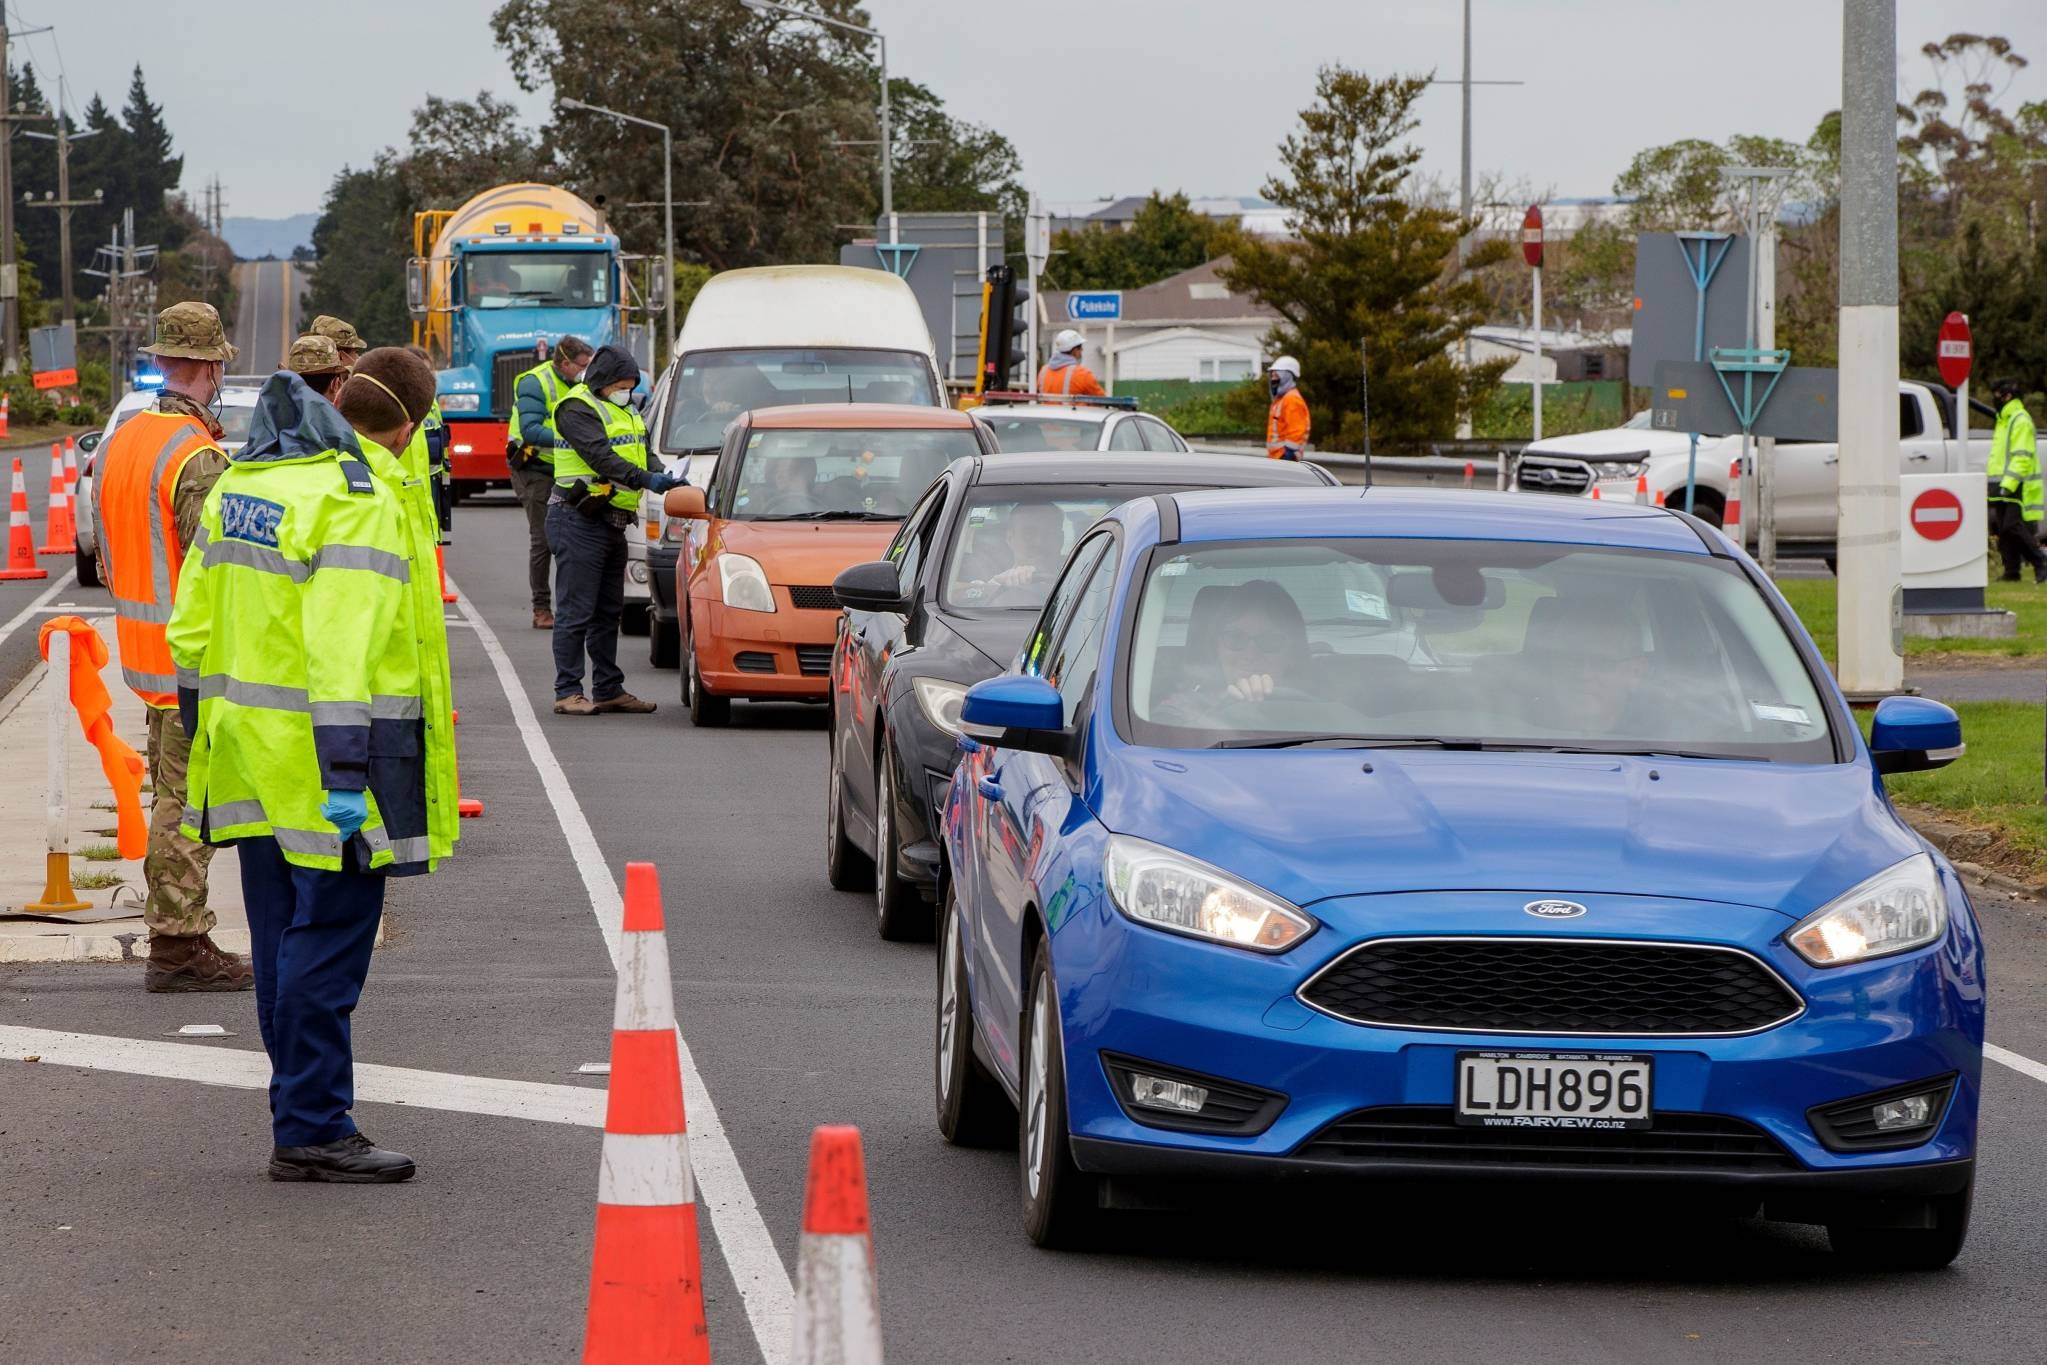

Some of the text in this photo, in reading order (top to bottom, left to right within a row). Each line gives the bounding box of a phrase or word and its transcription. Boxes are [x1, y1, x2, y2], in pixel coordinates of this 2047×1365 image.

[453, 382, 476, 390] 334
[1538, 903, 1573, 914] Ford
[1466, 1066, 1642, 1113] LDH896
[1484, 1116, 1626, 1129] www.FAIRVIEW.co.nz
